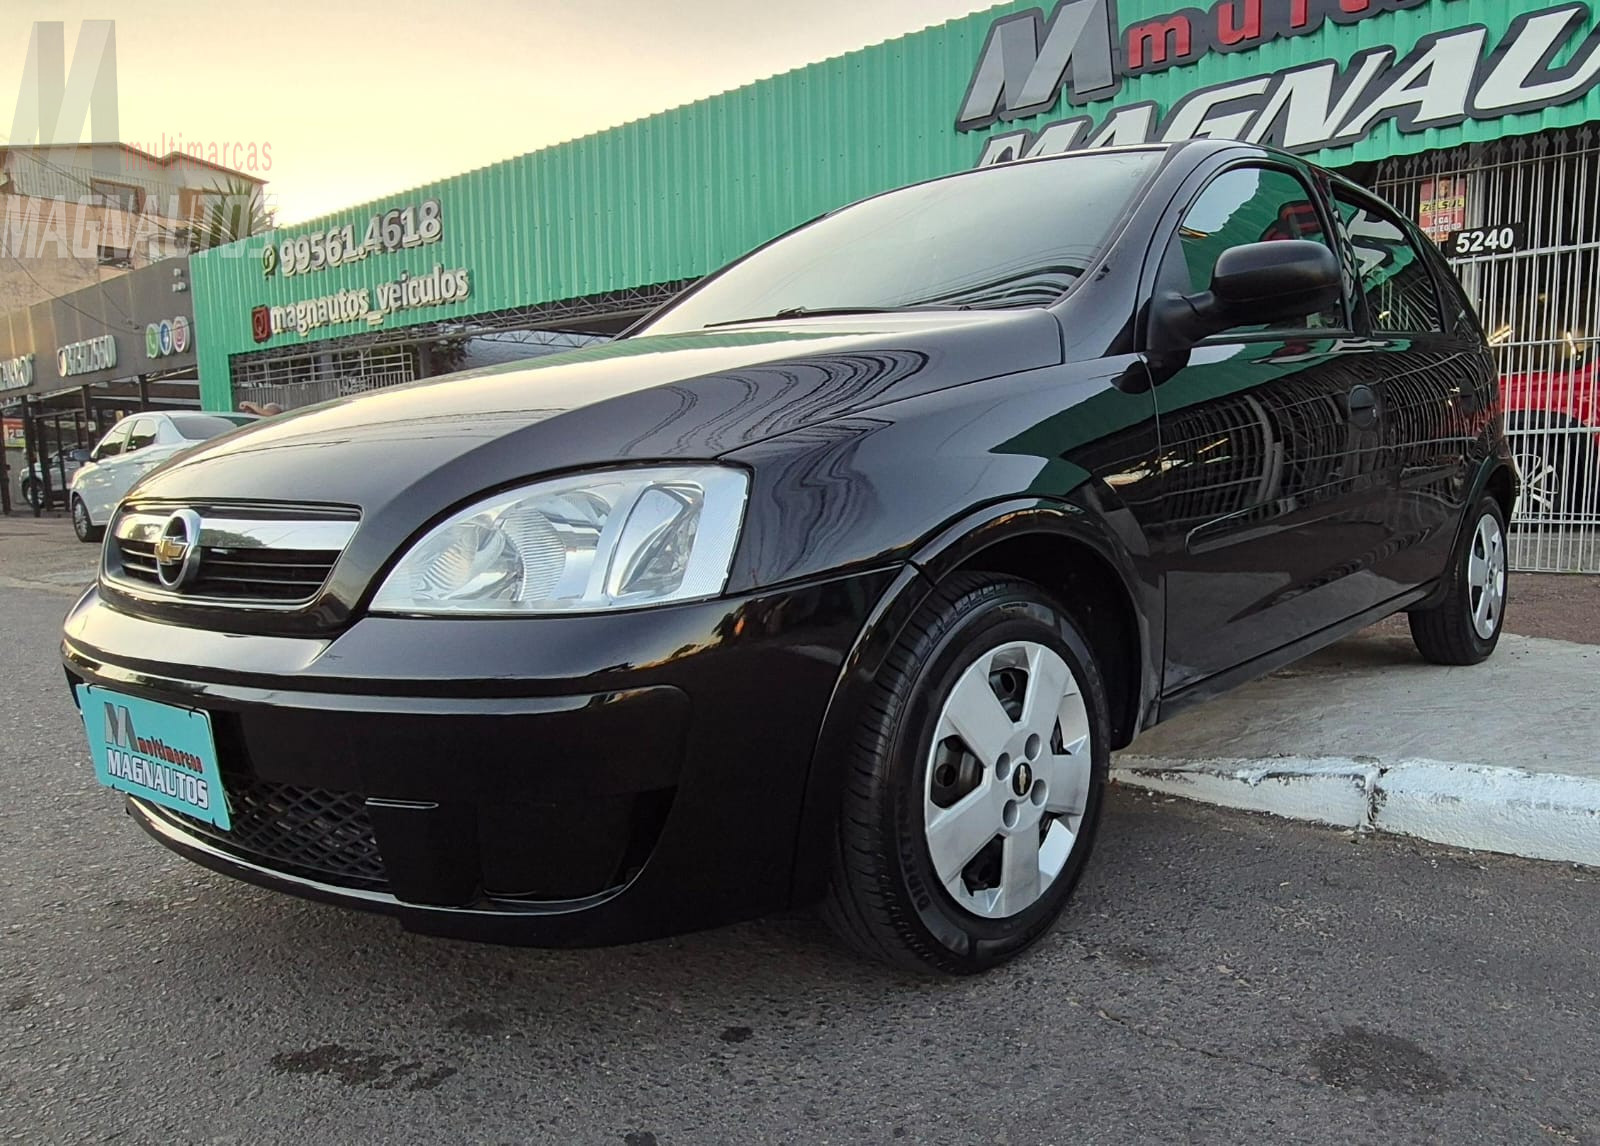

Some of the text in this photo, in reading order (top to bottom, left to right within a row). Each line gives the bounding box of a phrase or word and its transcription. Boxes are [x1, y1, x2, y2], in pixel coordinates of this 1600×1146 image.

[1127, 0, 1370, 69] mu
[280, 200, 441, 277] 99561.4618
[1455, 227, 1514, 254] 5240
[270, 262, 469, 337] magnautos_veiculos
[106, 747, 209, 810] MAGNAUTOS
